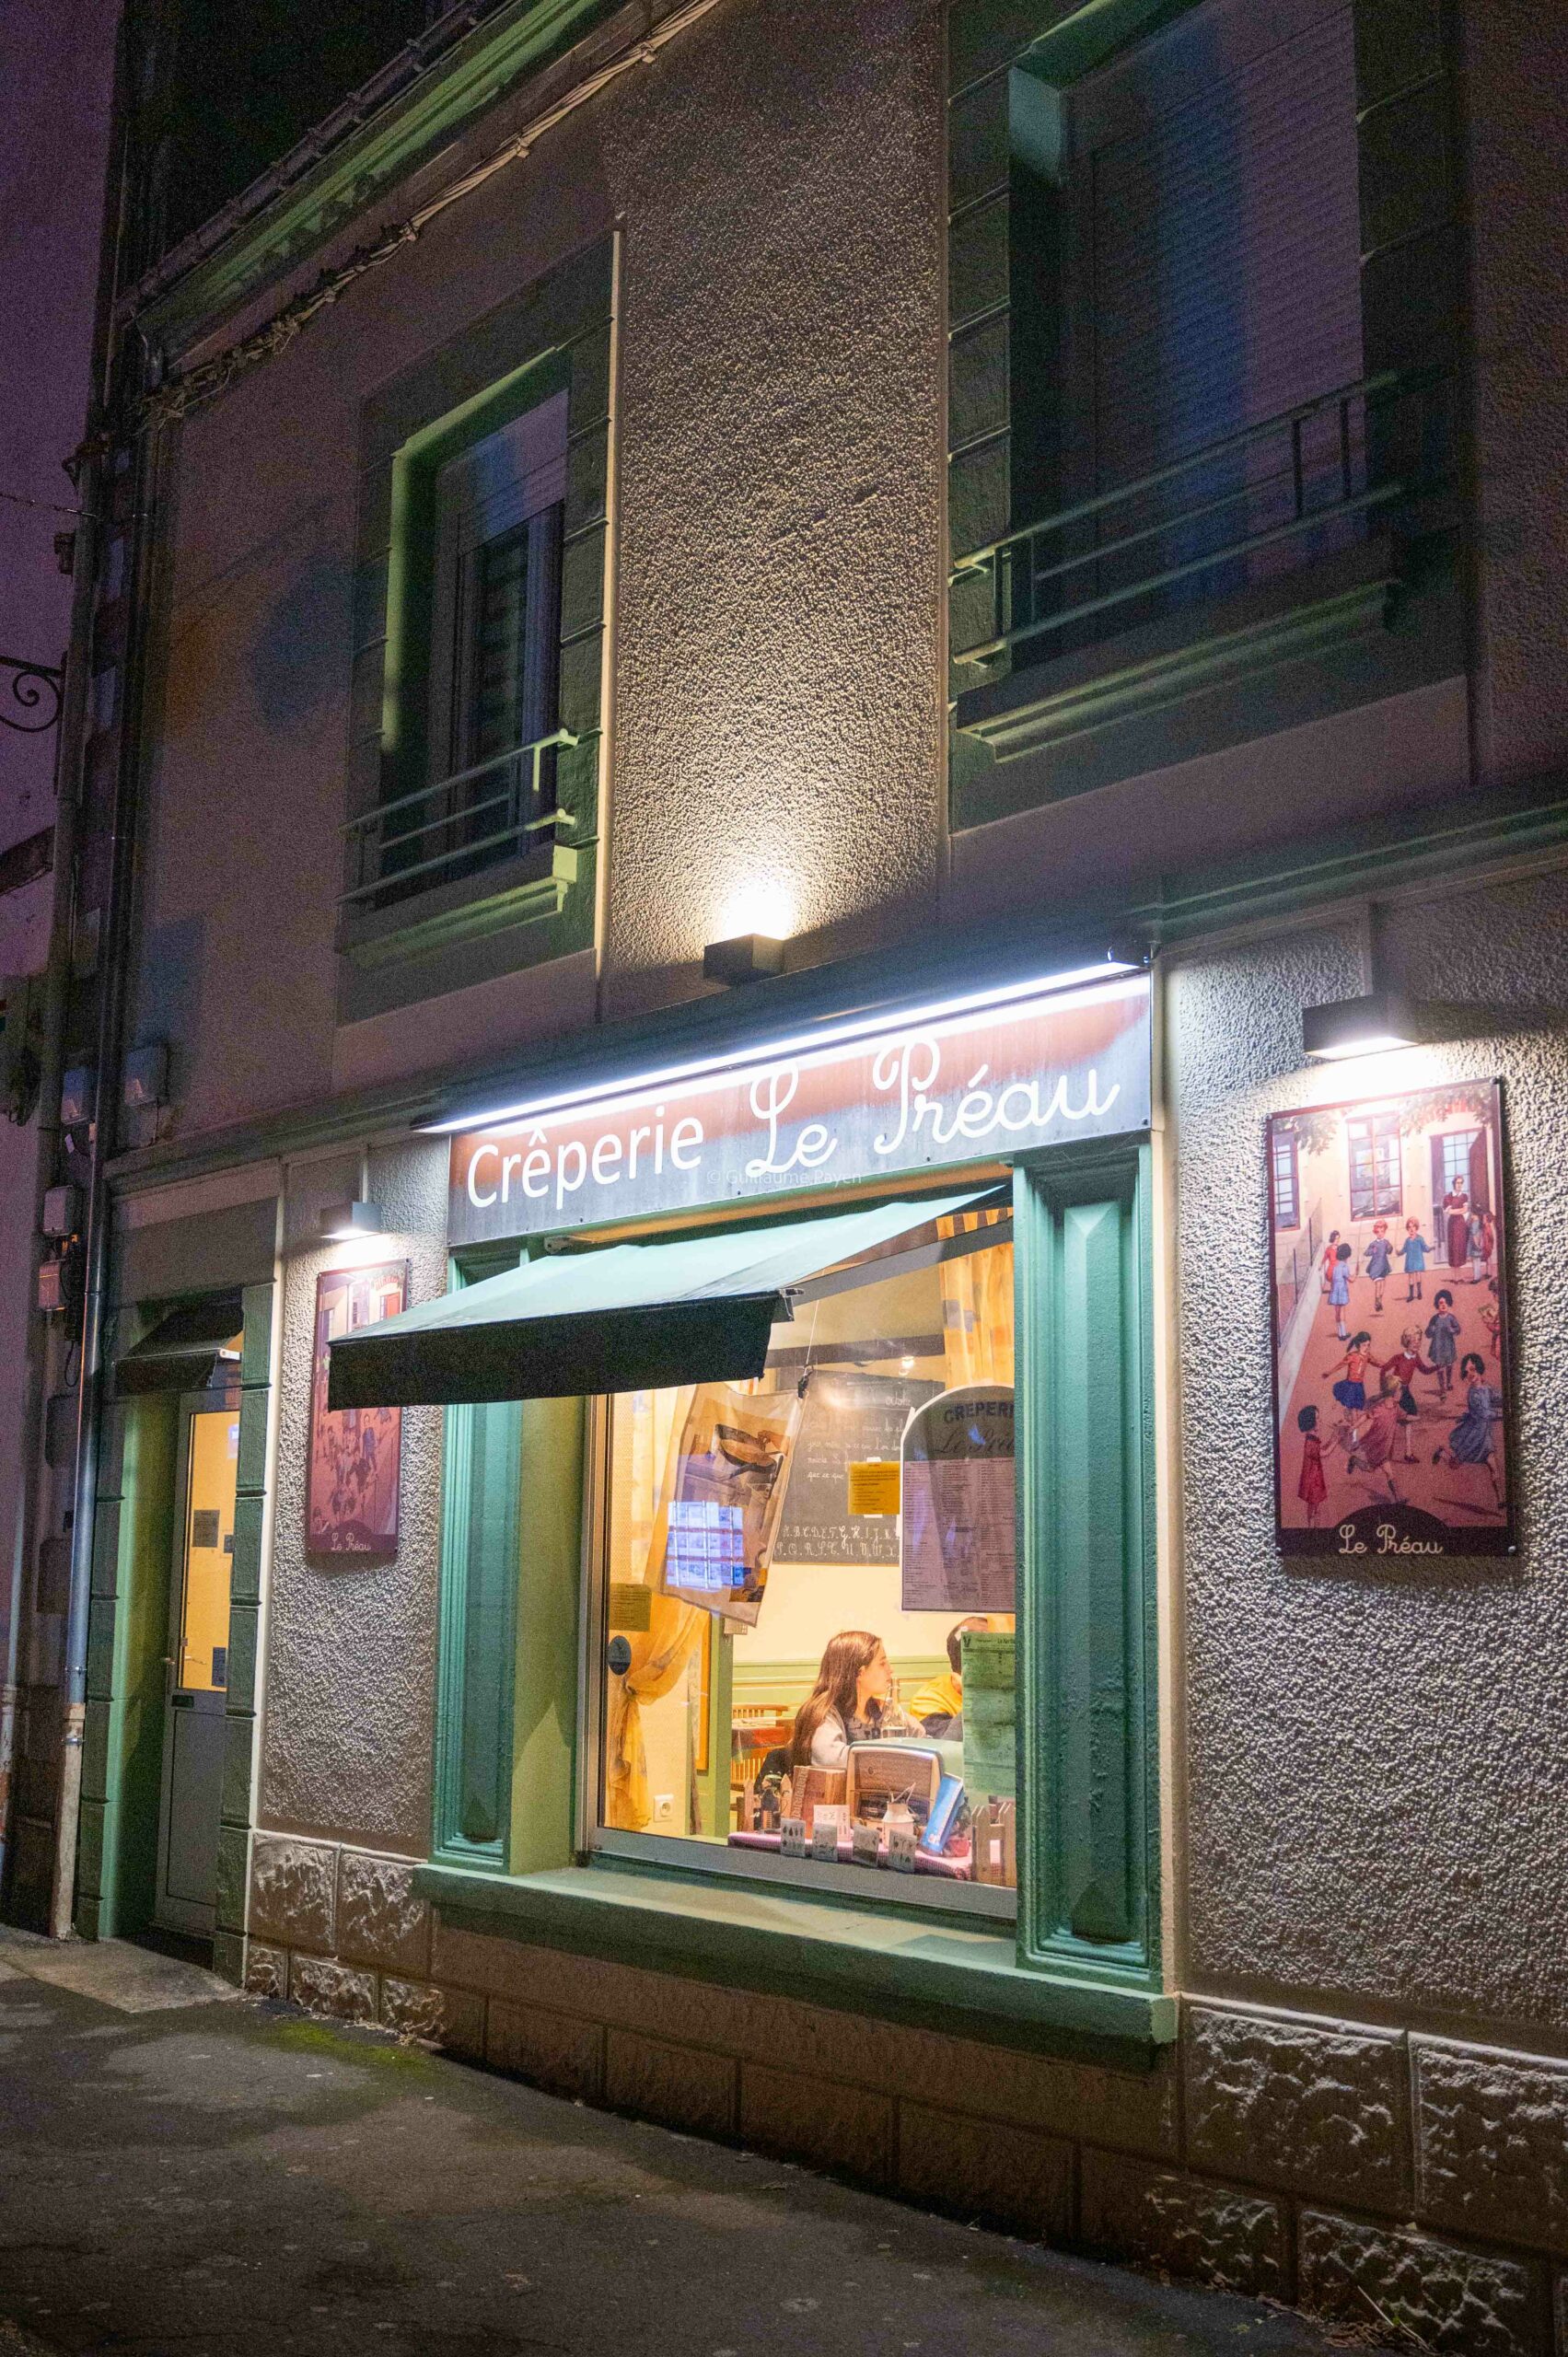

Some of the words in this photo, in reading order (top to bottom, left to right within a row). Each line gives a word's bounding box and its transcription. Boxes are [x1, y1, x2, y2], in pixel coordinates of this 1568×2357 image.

[467, 1105, 704, 1211] Crêperie
[745, 1062, 839, 1178] Le
[872, 1037, 1121, 1155] Préau
[1338, 1524, 1368, 1554] Le
[1376, 1523, 1444, 1554] Préau
